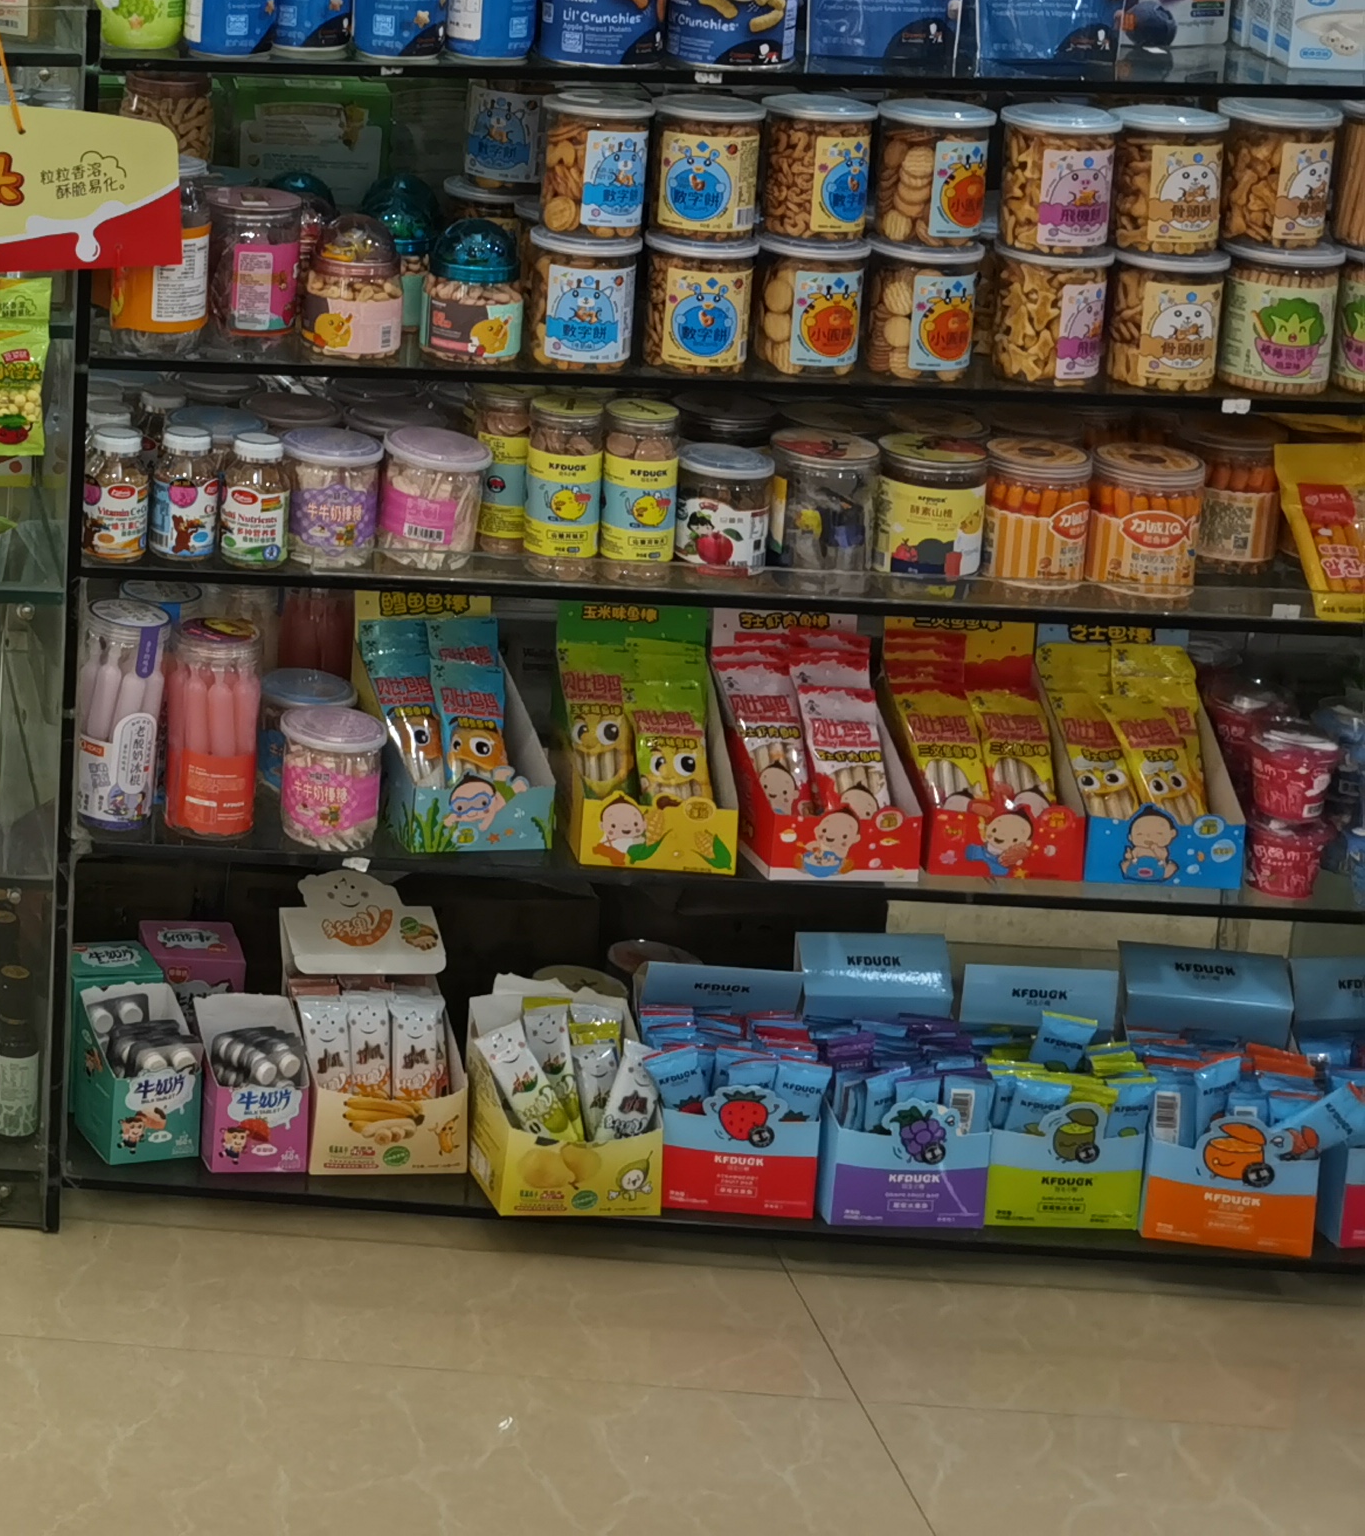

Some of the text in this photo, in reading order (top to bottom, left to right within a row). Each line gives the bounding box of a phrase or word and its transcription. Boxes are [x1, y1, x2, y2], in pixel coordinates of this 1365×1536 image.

[546, 323, 618, 342] 數字餅
[549, 462, 586, 473] KFDUCK
[237, 515, 278, 524] Nutrients
[582, 605, 658, 623] 玉米味鱼棒
[847, 956, 901, 969] KFDUCK
[695, 982, 751, 995] KFDUCK
[1012, 988, 1067, 1001] KFDUCK
[137, 1074, 186, 1096] 牛奶片
[237, 1088, 292, 1110] 牛奶片
[714, 1156, 764, 1168] KFDUCK
[1041, 1175, 1093, 1187] KFDUCK
[1204, 1194, 1261, 1207] KFDUCK
